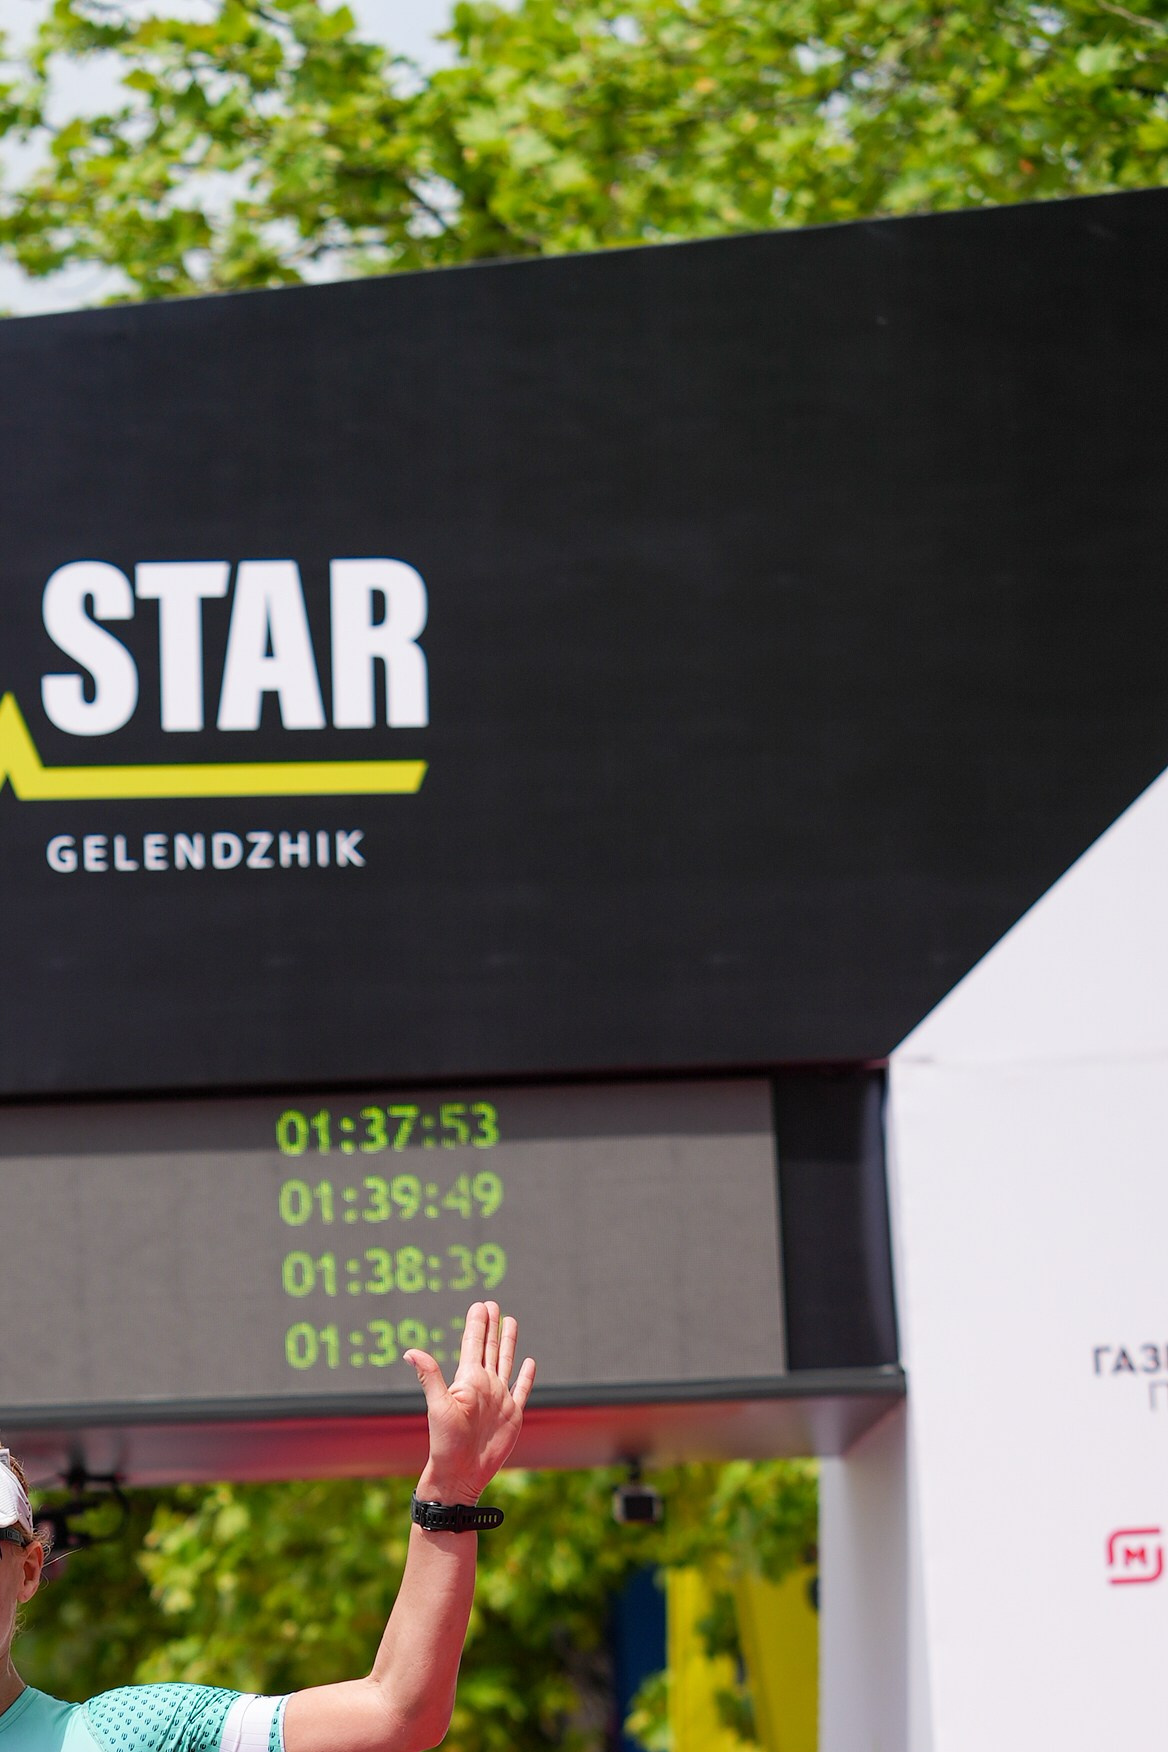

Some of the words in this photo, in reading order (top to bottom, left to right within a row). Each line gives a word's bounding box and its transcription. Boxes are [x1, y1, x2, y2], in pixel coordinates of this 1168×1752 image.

[41, 558, 428, 736] STAR
[46, 831, 364, 872] GELENDZHIK
[275, 1100, 500, 1156] 01:37:53
[278, 1170, 504, 1226] 01:39:49
[281, 1242, 507, 1297] 01:38:39
[284, 1314, 504, 1369] 01:39:
[1093, 1343, 1168, 1377] ГАЗ
